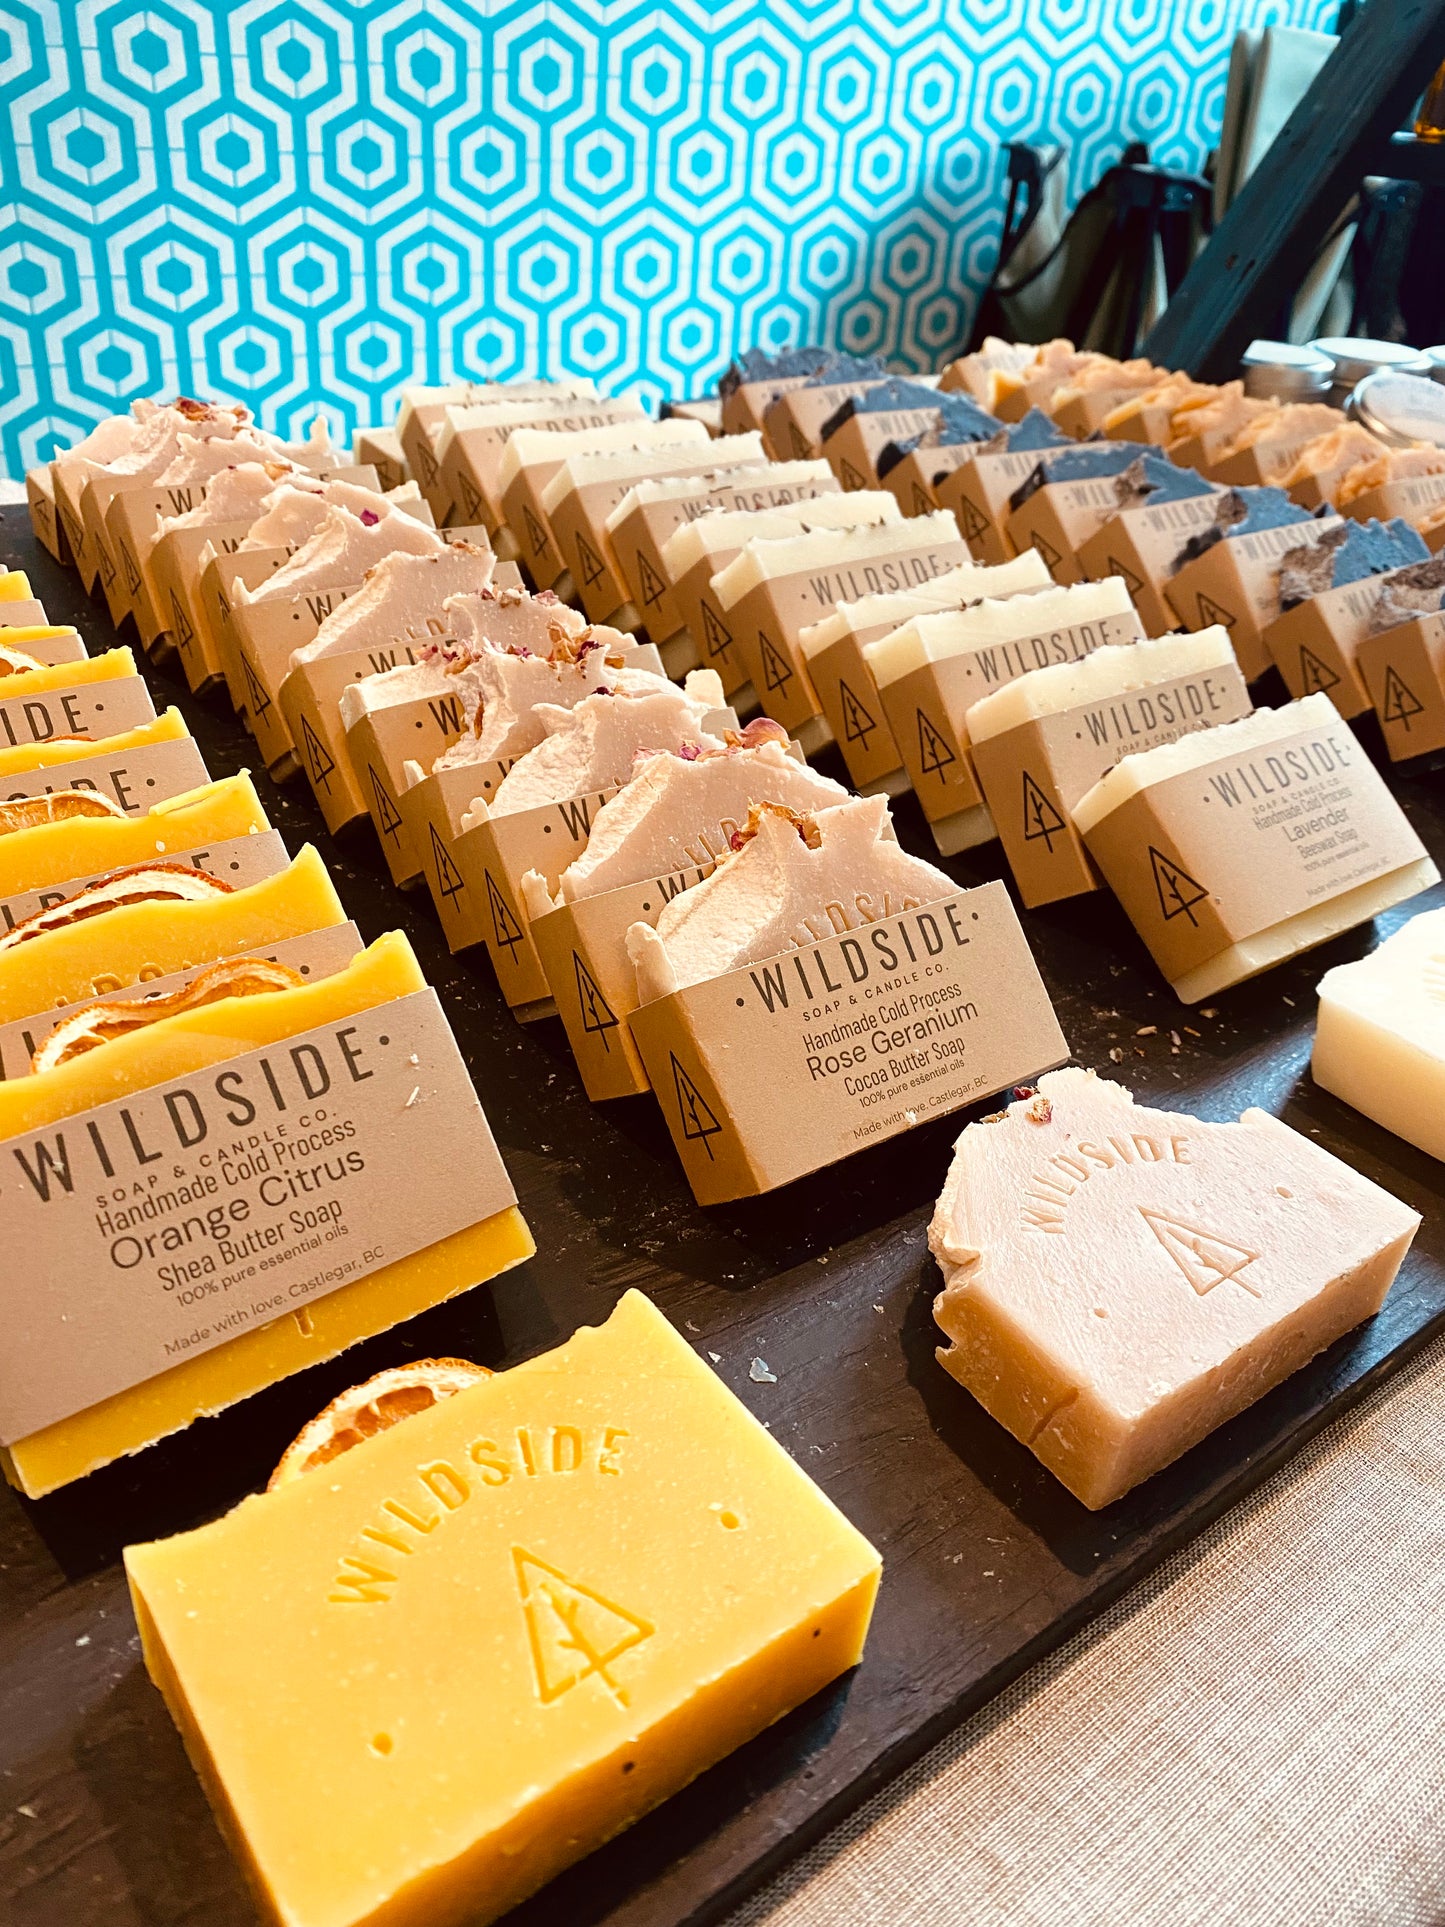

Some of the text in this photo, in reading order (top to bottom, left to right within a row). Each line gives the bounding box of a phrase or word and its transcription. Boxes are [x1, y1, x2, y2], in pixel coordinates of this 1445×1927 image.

[1083, 679, 1221, 746] WILDSIDE
[1208, 737, 1351, 808] WILDSIDE
[1252, 804, 1303, 831] Handmade
[1282, 807, 1351, 842] Lavender
[1297, 836, 1337, 859] Beeswax
[749, 903, 970, 1014] WILDSIDE
[803, 963, 950, 1021] SOAP & CANDLE CO.
[802, 983, 962, 1053] Handmade Cold Process
[806, 1002, 979, 1081] Rose Geranium
[844, 1037, 966, 1096] Cocoa Butter Soap
[859, 1058, 965, 1108] 100% pure essential oils
[13, 1027, 374, 1203] WILDSIDE
[853, 1120, 882, 1140] Made
[883, 1109, 905, 1126] with
[973, 1074, 989, 1090] BC
[95, 1120, 356, 1238] Handmade Cold Process
[96, 1109, 337, 1208] SOAP & CANDLE CO.
[1020, 1132, 1193, 1234] WILDSIDE
[110, 1151, 365, 1269] Orange Citrus
[157, 1200, 343, 1292] Shea Butter Soap
[163, 1245, 386, 1356] Made with love. Castlegar, BC
[177, 1223, 349, 1307] 100% pure essential oils
[327, 1424, 631, 1603] WILDSIDE
